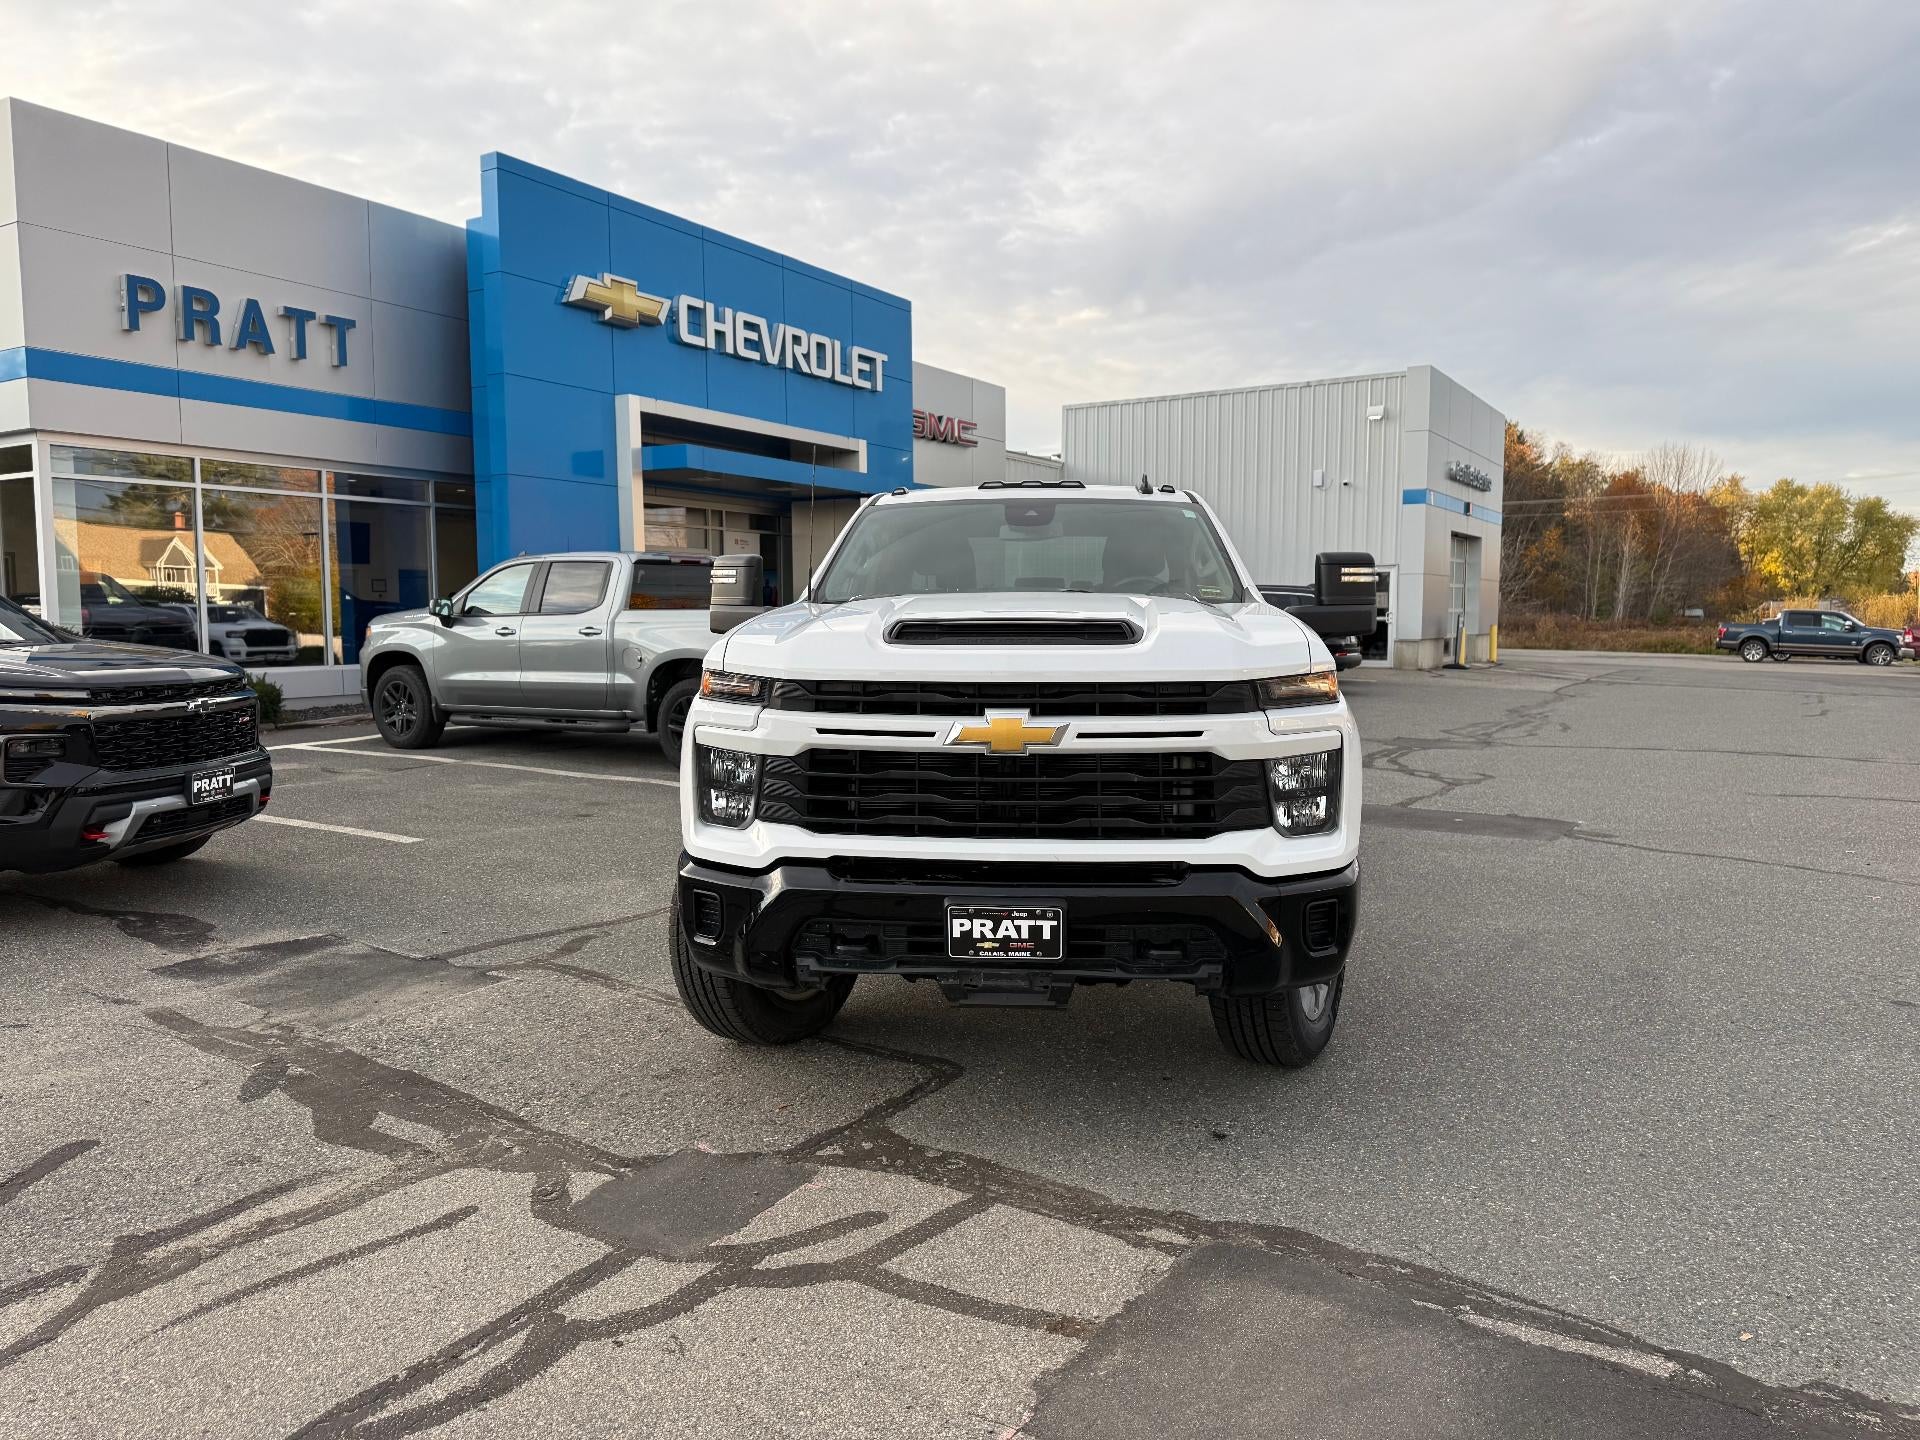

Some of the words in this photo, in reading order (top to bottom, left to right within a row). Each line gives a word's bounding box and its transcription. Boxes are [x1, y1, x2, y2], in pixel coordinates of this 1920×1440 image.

[121, 274, 357, 368] PRATT
[677, 294, 889, 392] CHEVROLET
[193, 774, 234, 793] PRATT
[1011, 910, 1028, 918] Jeep
[952, 918, 1058, 940] PRATT
